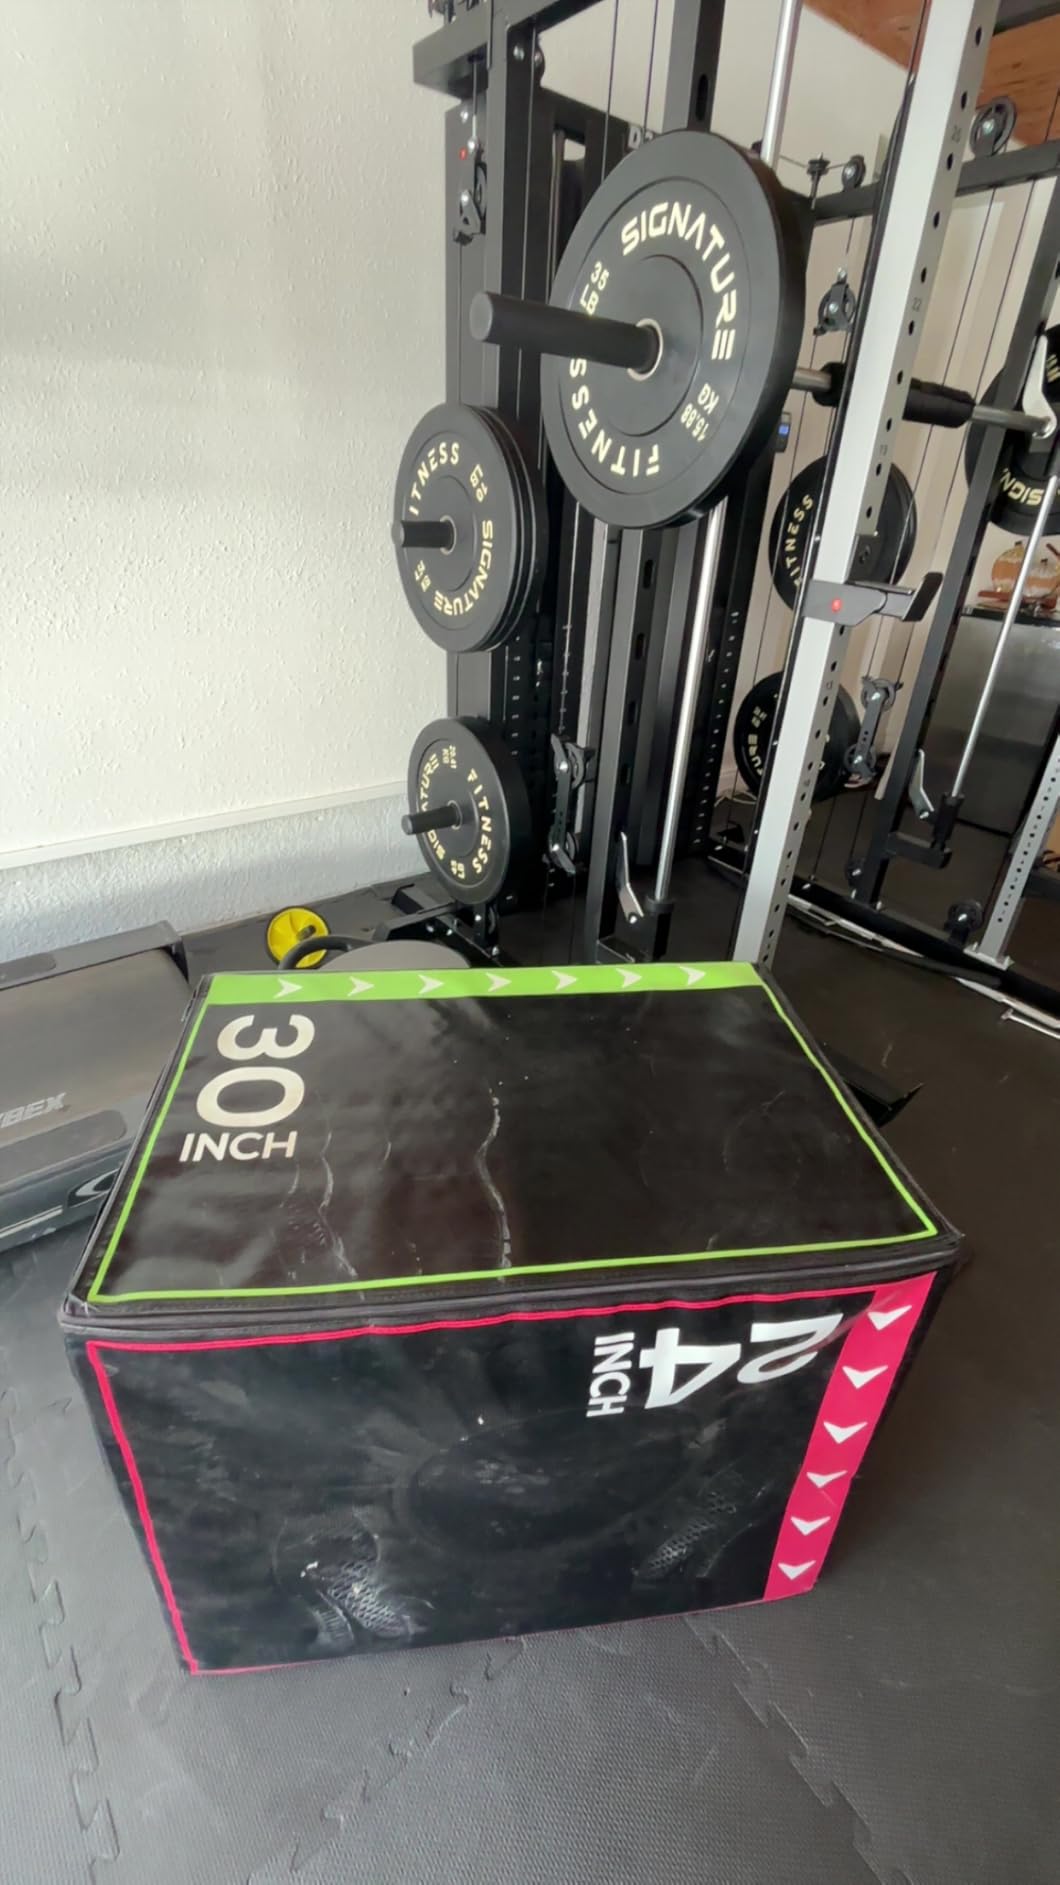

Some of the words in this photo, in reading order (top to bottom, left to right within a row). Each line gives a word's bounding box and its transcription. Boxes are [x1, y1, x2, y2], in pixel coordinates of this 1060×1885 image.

[580, 284, 599, 315] LB
[590, 261, 609, 291] 35
[621, 201, 737, 360] SIGNATURE
[569, 357, 661, 478] FITNESS
[681, 403, 709, 441] 15.88
[698, 383, 719, 415] KG
[409, 442, 460, 516] ITNESS
[470, 464, 483, 488] LB
[434, 520, 494, 616] SIGNATURE
[419, 753, 446, 860] SIGATURE
[466, 768, 492, 873] FITNESS
[0, 1092, 67, 1128] BEX
[196, 1014, 315, 1127] 30
[179, 1131, 297, 1162] INCH
[586, 1332, 635, 1417] INCH
[639, 1313, 844, 1409] 24
